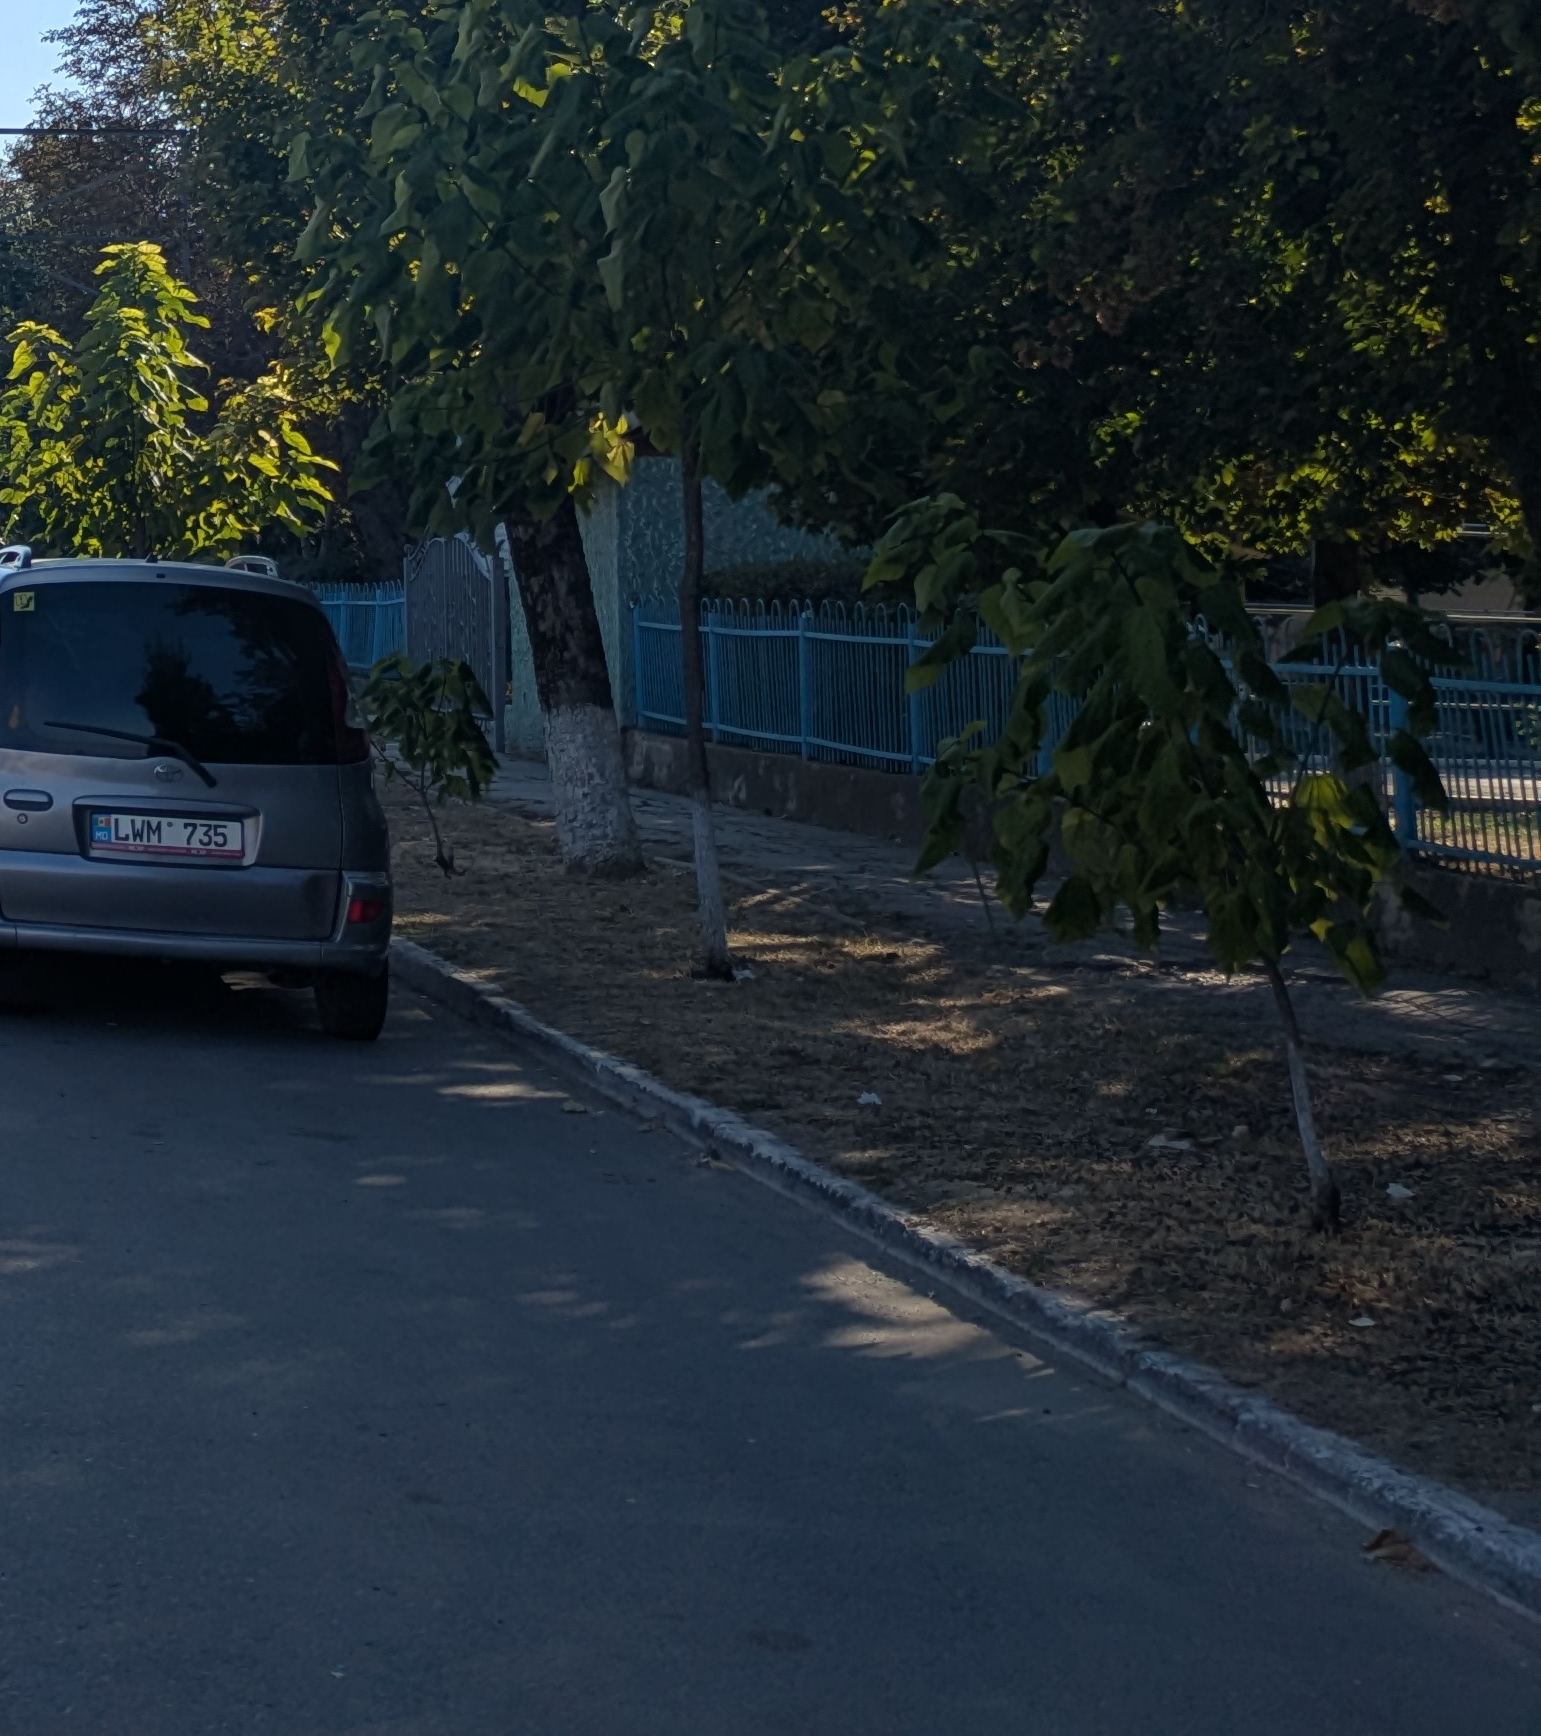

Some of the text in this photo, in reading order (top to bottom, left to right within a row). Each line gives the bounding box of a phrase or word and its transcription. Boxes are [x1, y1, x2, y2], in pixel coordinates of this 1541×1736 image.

[95, 831, 108, 840] MD
[114, 818, 228, 848] LWM 735
